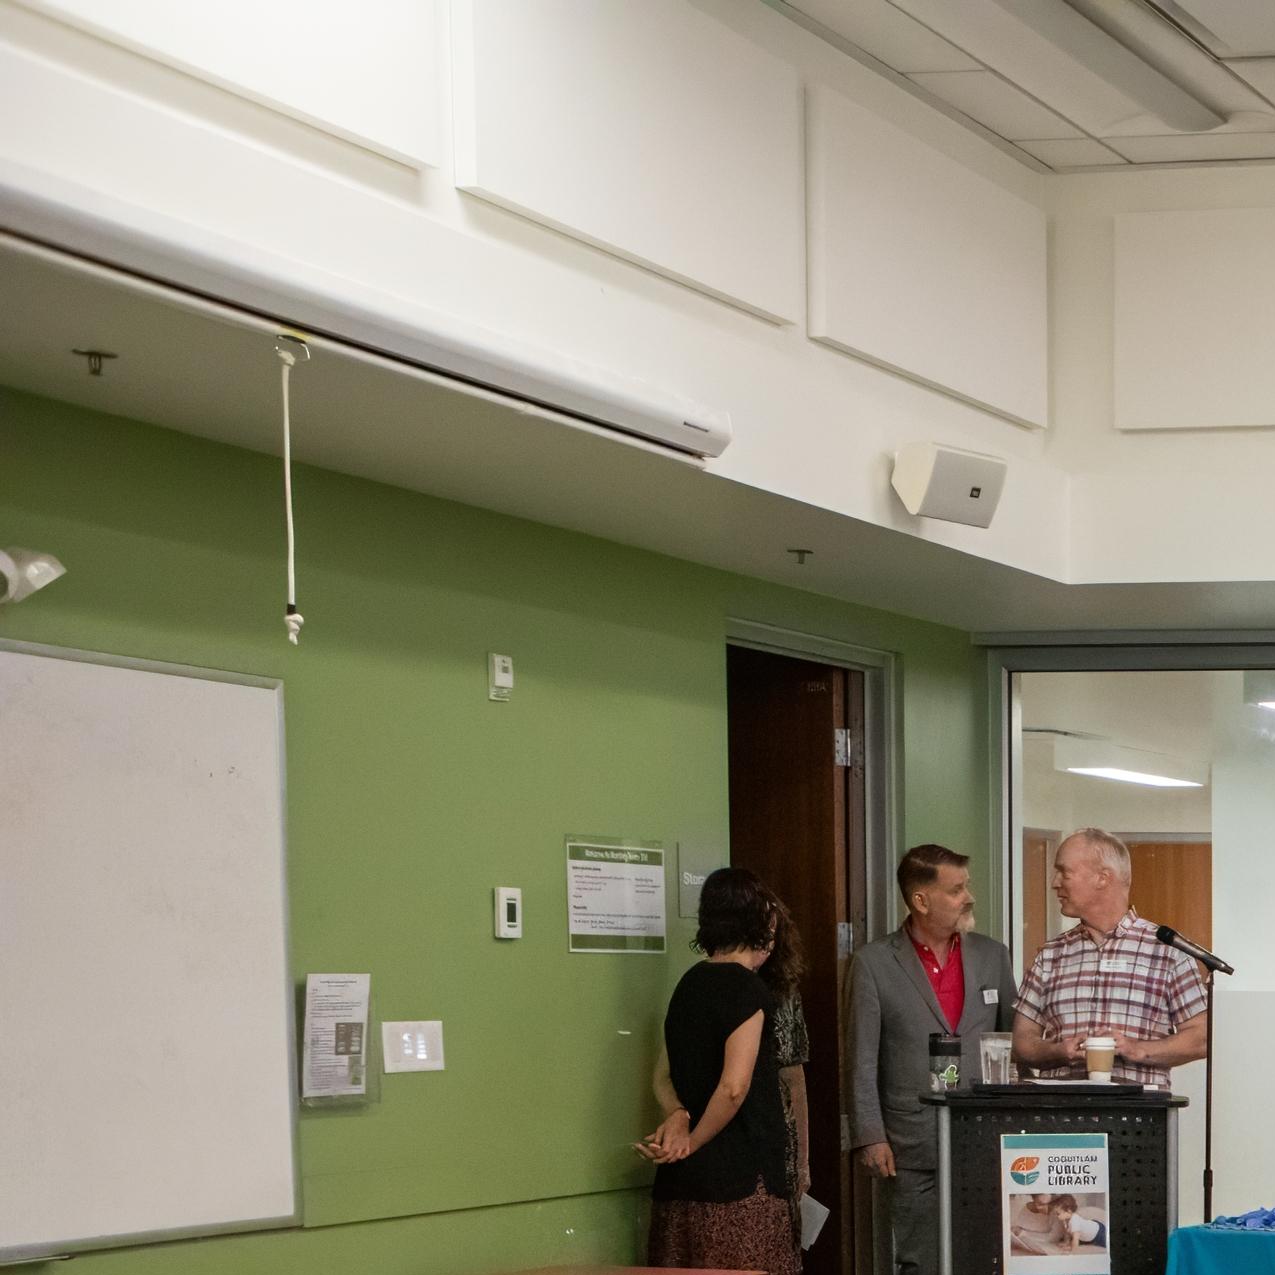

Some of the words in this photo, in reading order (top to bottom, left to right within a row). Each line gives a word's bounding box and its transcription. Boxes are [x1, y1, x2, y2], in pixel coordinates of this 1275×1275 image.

[1047, 1155, 1099, 1163] COQUITLAM
[1047, 1165, 1091, 1175] PUBLIC
[1047, 1175, 1098, 1186] LIBRARY
